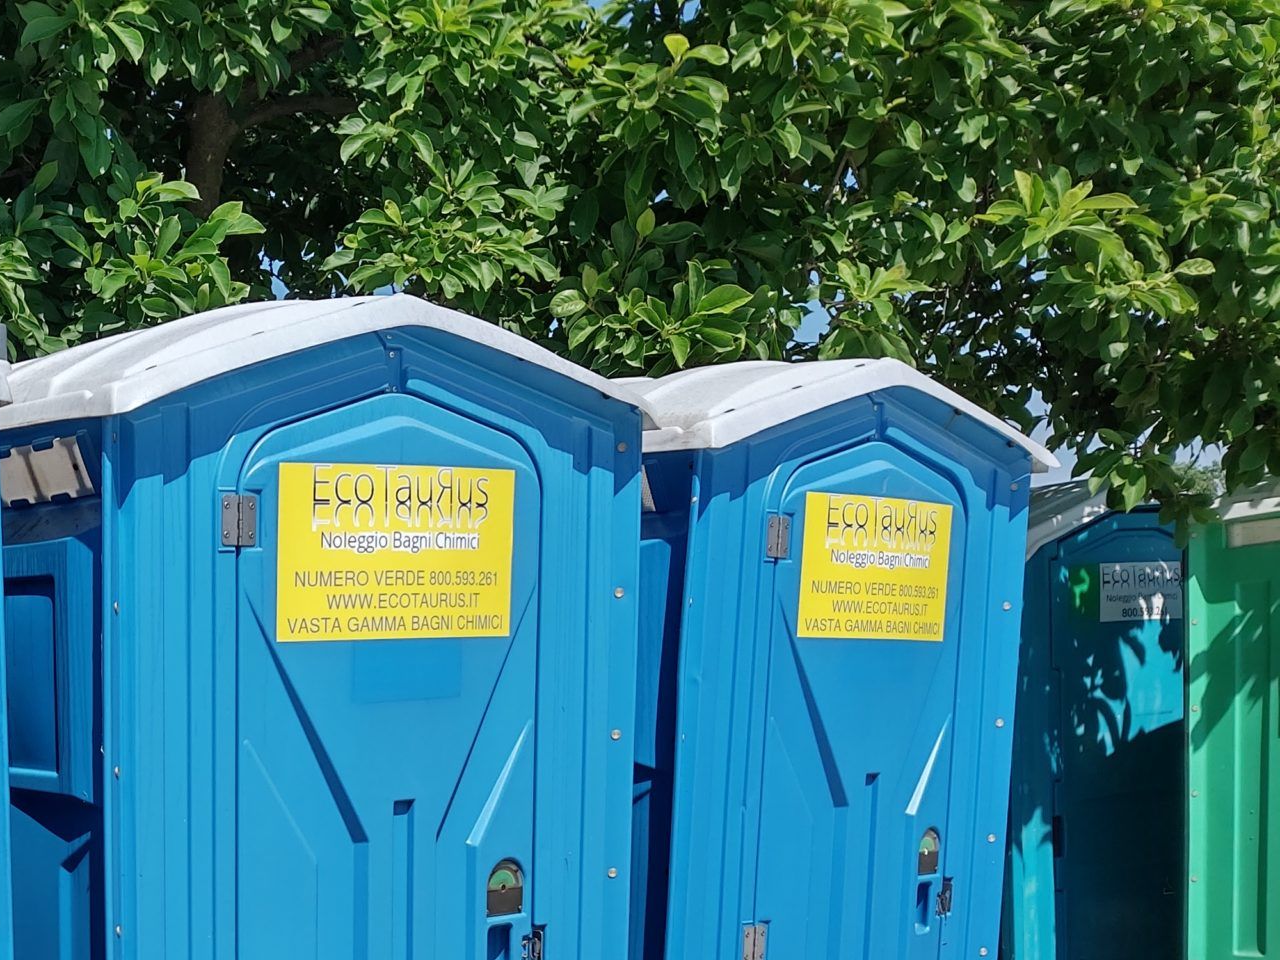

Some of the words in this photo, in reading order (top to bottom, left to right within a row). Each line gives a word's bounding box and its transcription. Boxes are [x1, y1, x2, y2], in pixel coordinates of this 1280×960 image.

[320, 531, 388, 554] Noleggio
[393, 532, 432, 553] Bagni
[435, 532, 480, 549] Chimici
[830, 549, 875, 568] Noleggio
[877, 551, 903, 569] Bagni
[904, 552, 930, 569] Chimici
[294, 571, 369, 587] NUMERO
[374, 571, 425, 587] VERDE
[429, 571, 498, 586] 800.593.261
[811, 580, 862, 595] NUMERO
[865, 582, 896, 596] VERDE
[898, 584, 939, 599] 800.593.261
[326, 593, 480, 610] WWW.ECOTAURUS.IT
[832, 600, 928, 616] WWW.ECOTAURUS.IT
[287, 618, 342, 633] VASTA
[347, 616, 406, 632] GAMMA
[411, 616, 452, 631] BAGNI
[457, 615, 502, 630] CHIMICI
[805, 618, 841, 632] VASTA
[844, 619, 883, 633] GAMMA
[885, 620, 912, 634] BAGNI
[913, 621, 939, 635] CHIMICI
